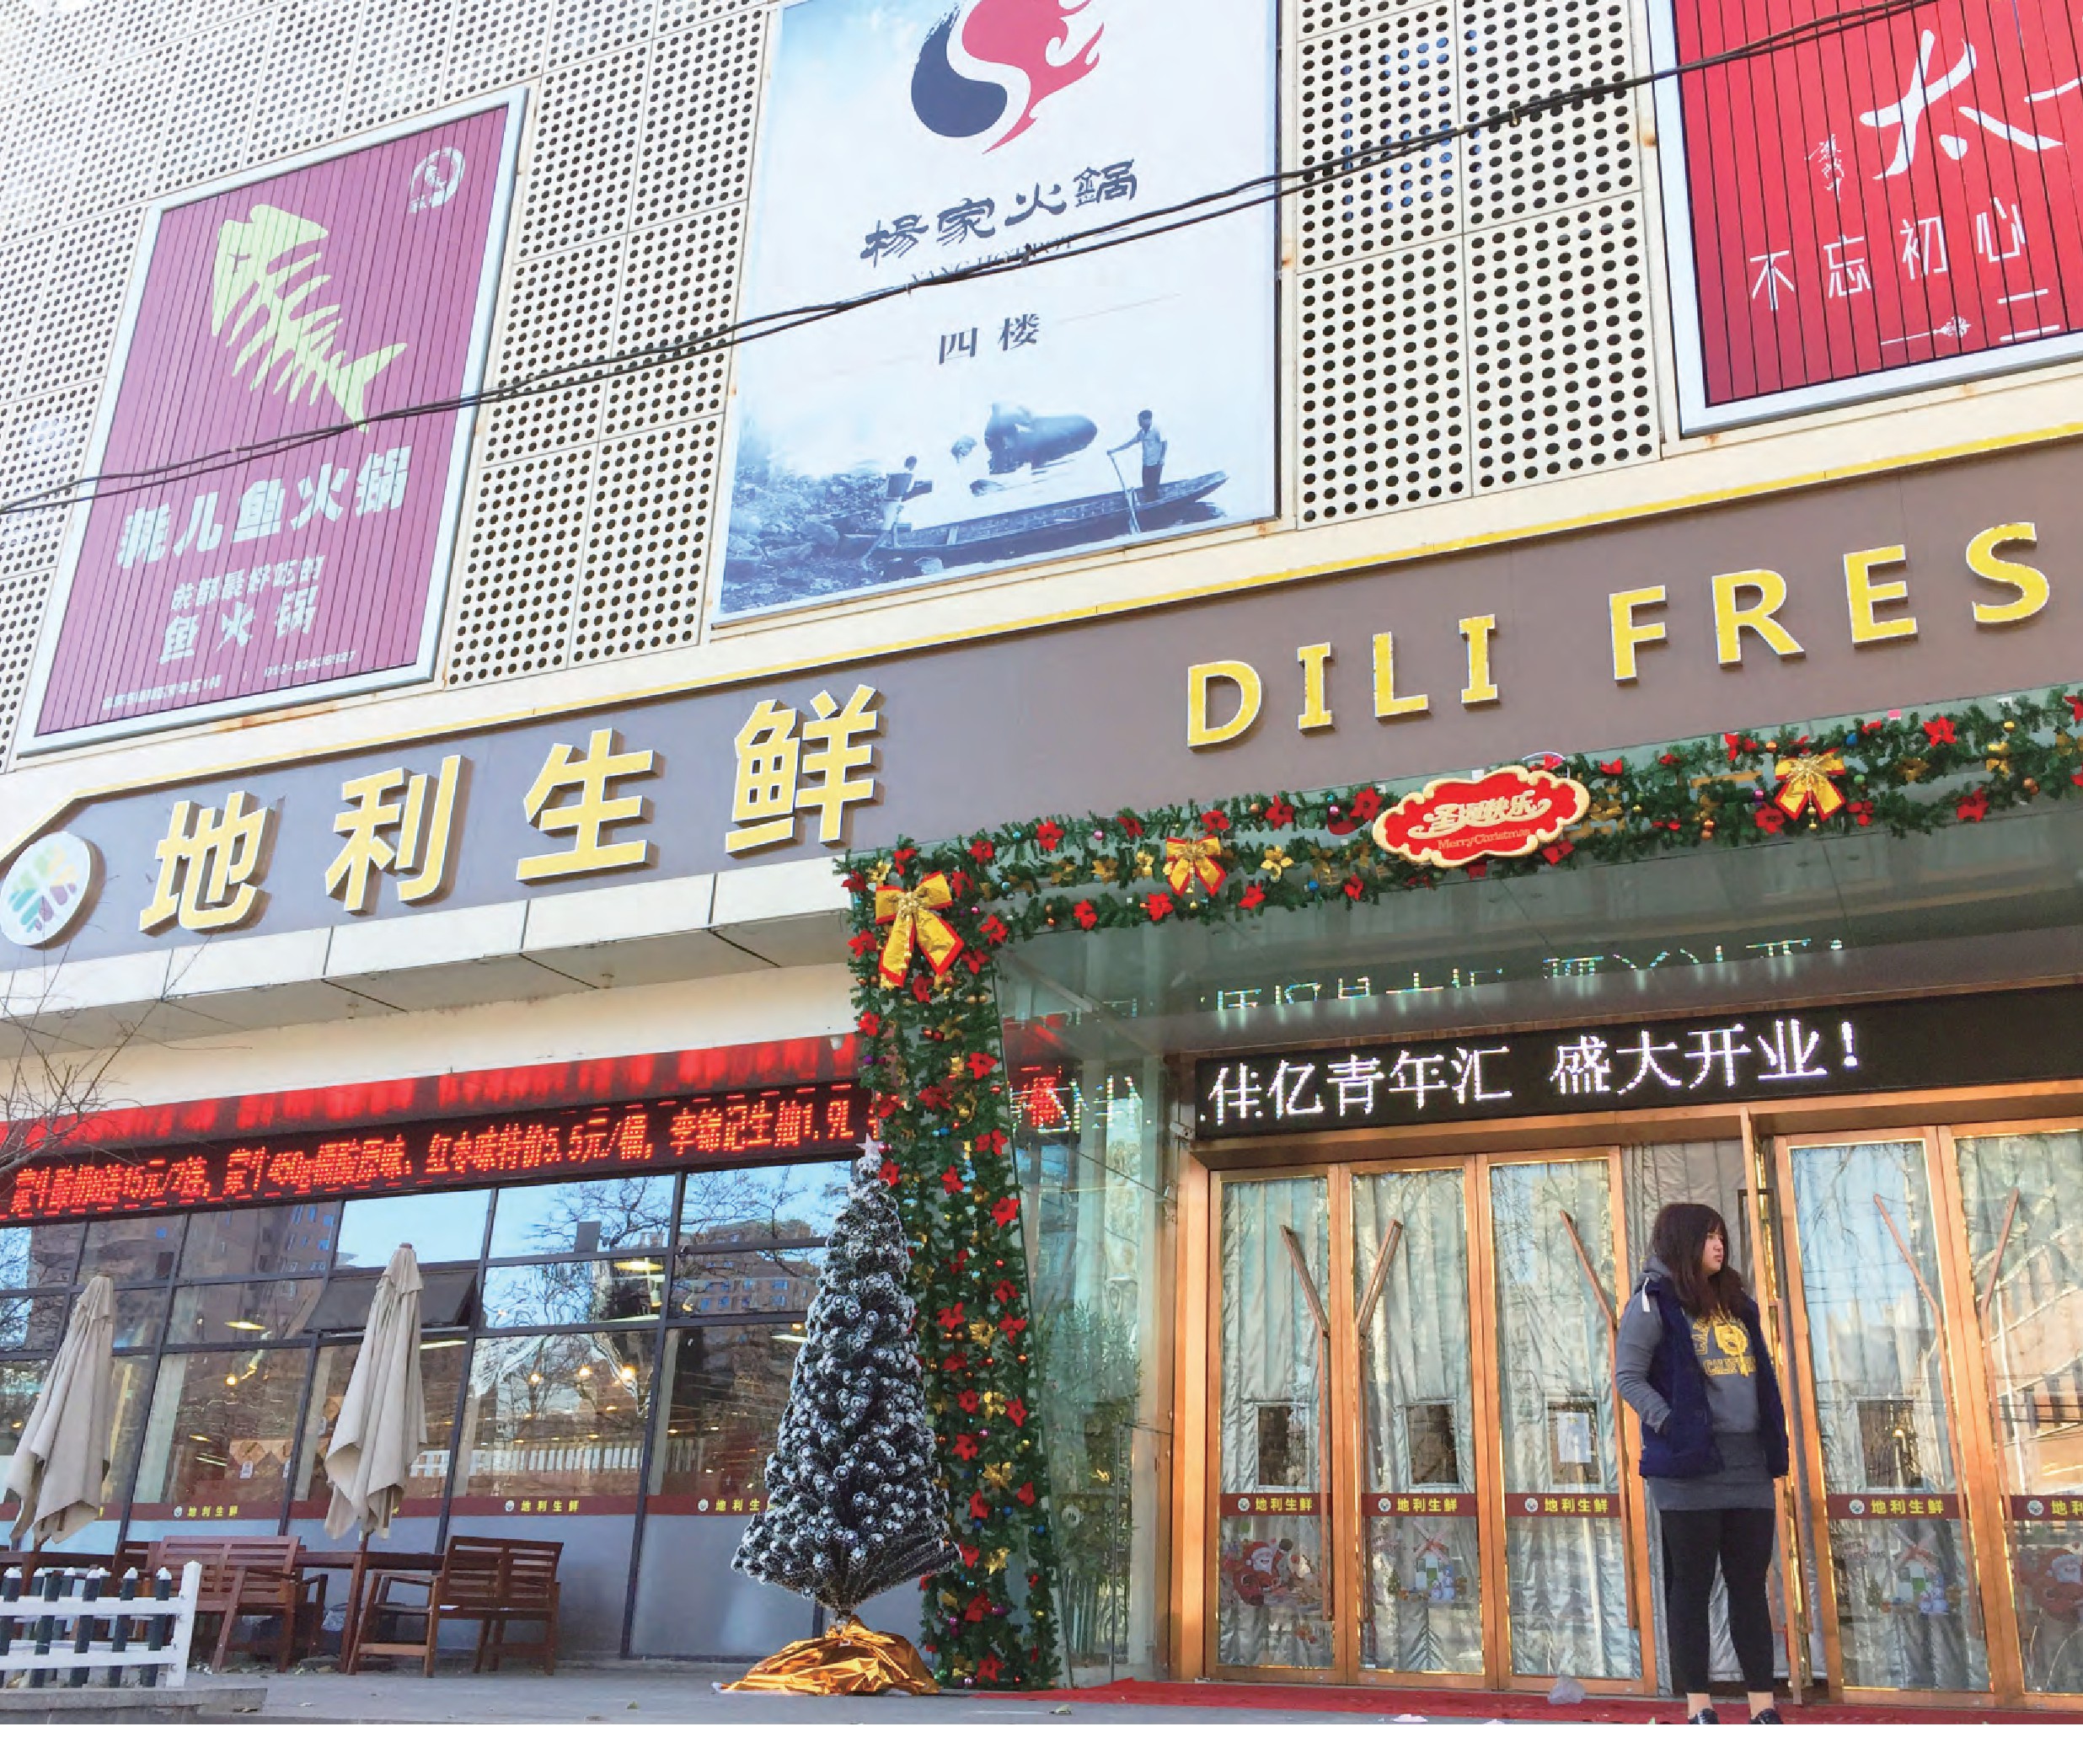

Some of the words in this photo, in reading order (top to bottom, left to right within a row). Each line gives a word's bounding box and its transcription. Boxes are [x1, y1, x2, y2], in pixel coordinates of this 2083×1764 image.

[1859, 29, 2083, 180] 太
[1749, 197, 2027, 312] 不忘初心
[938, 313, 1040, 366] 四楼
[158, 585, 319, 666] 鱼火锅
[1186, 613, 1504, 750] DILI
[1609, 521, 2053, 682] FRES
[138, 683, 885, 933] 地利生鲜
[1207, 1045, 1513, 1126] 佳亿青年汇
[715, 1498, 773, 1511] 地利生
[1255, 1497, 1313, 1512] 地利生鲜
[1396, 1497, 1459, 1513] 地利生鲜
[1544, 1498, 1609, 1513] 地利生鲜
[1870, 1499, 1944, 1515] 地利生鲜
